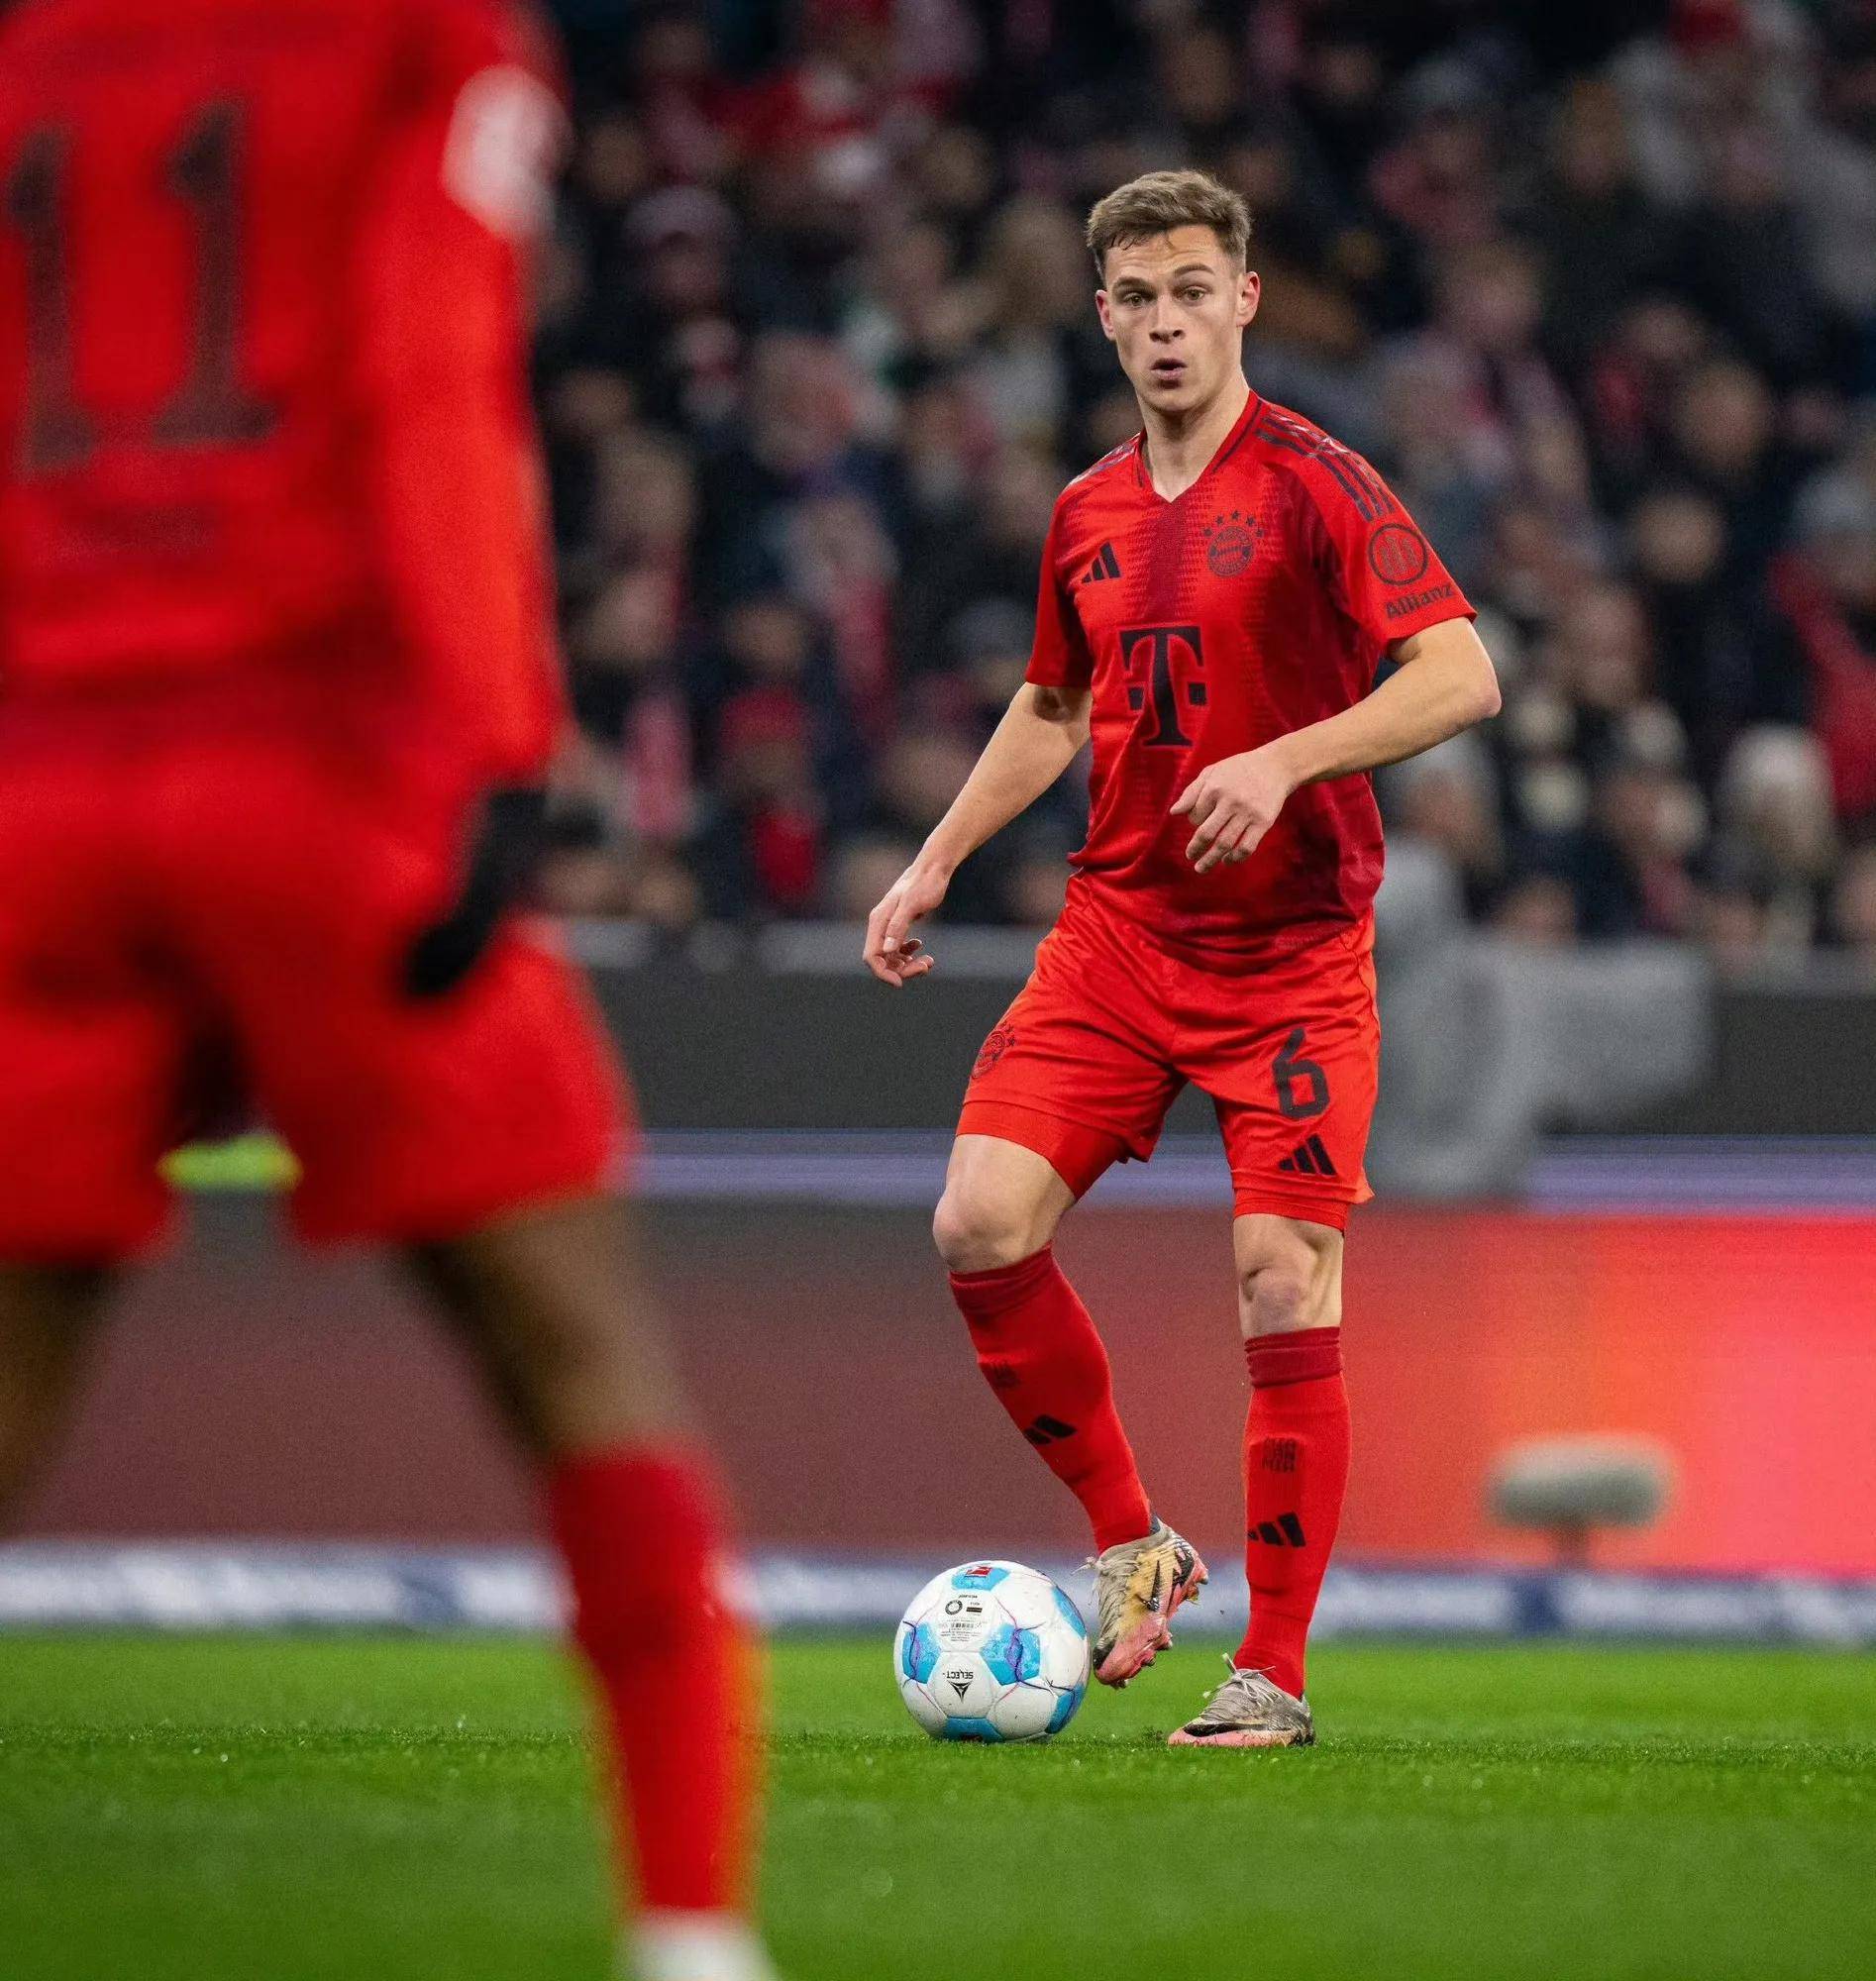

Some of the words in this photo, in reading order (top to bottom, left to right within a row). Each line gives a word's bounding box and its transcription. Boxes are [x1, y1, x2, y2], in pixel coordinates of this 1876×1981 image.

[5, 97, 281, 469] 11
[1386, 581, 1454, 618] Allianz
[1119, 625, 1206, 748] T
[1272, 1027, 1330, 1120] 6
[946, 1669, 974, 1680] SELECT
